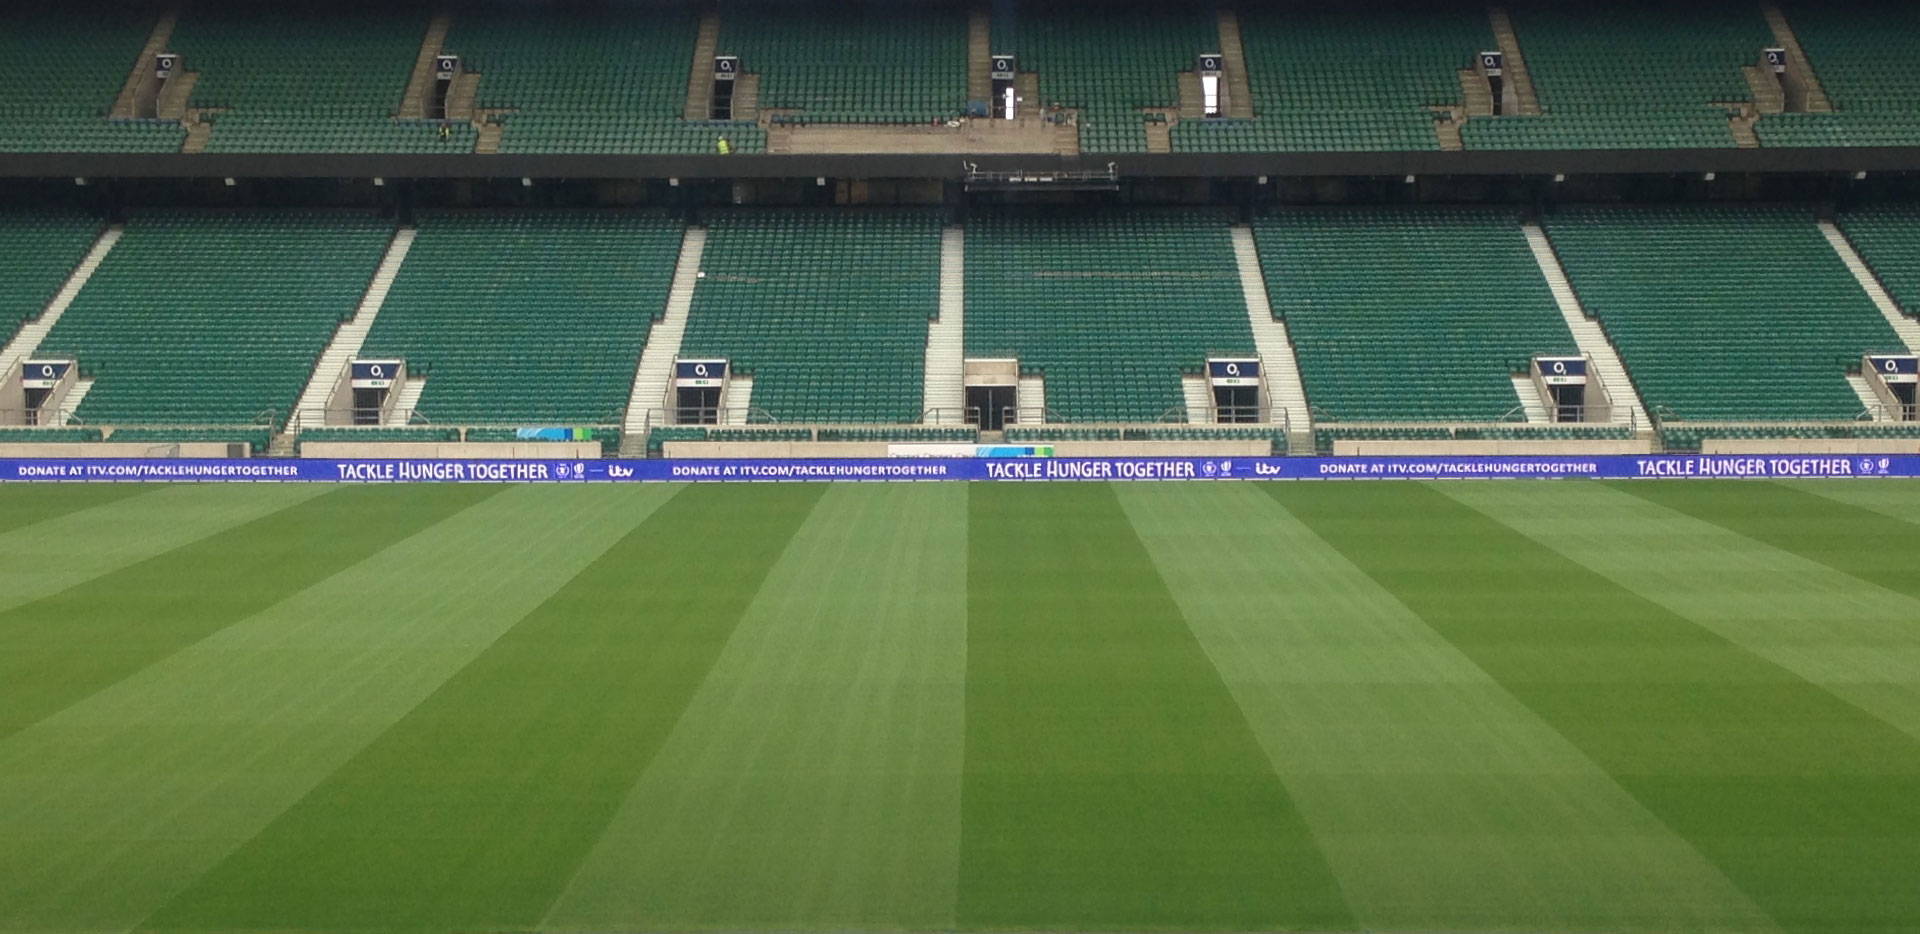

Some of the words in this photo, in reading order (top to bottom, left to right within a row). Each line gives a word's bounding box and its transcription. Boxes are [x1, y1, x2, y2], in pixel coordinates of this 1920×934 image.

[18, 465, 66, 477] DONATE
[68, 465, 83, 477] AT
[86, 465, 298, 477] ITV.COM/TACKLEHUNGERTOGETHER
[337, 463, 394, 480] TACKLE
[399, 462, 465, 480] HUNGER
[468, 462, 549, 480] TOGETHER
[608, 463, 634, 478] itv
[672, 465, 720, 477] DONATE
[722, 465, 737, 477] AT
[739, 465, 947, 477] ITV.COM/TACKLEHUNGERTOGETHER
[986, 462, 1042, 478] TACKLE
[1047, 460, 1112, 478] HUNGER
[1114, 460, 1195, 478] TOGETHER
[1255, 461, 1281, 476] itv
[1319, 463, 1368, 475] DONATE
[1369, 463, 1385, 475] AT
[1387, 463, 1597, 475] ITV.COM/TACKLEHUNGERTOGETHER
[1637, 459, 1694, 477] TACKLE
[1700, 458, 1765, 476] HUNGER
[1769, 458, 1852, 476] TOGETHER
